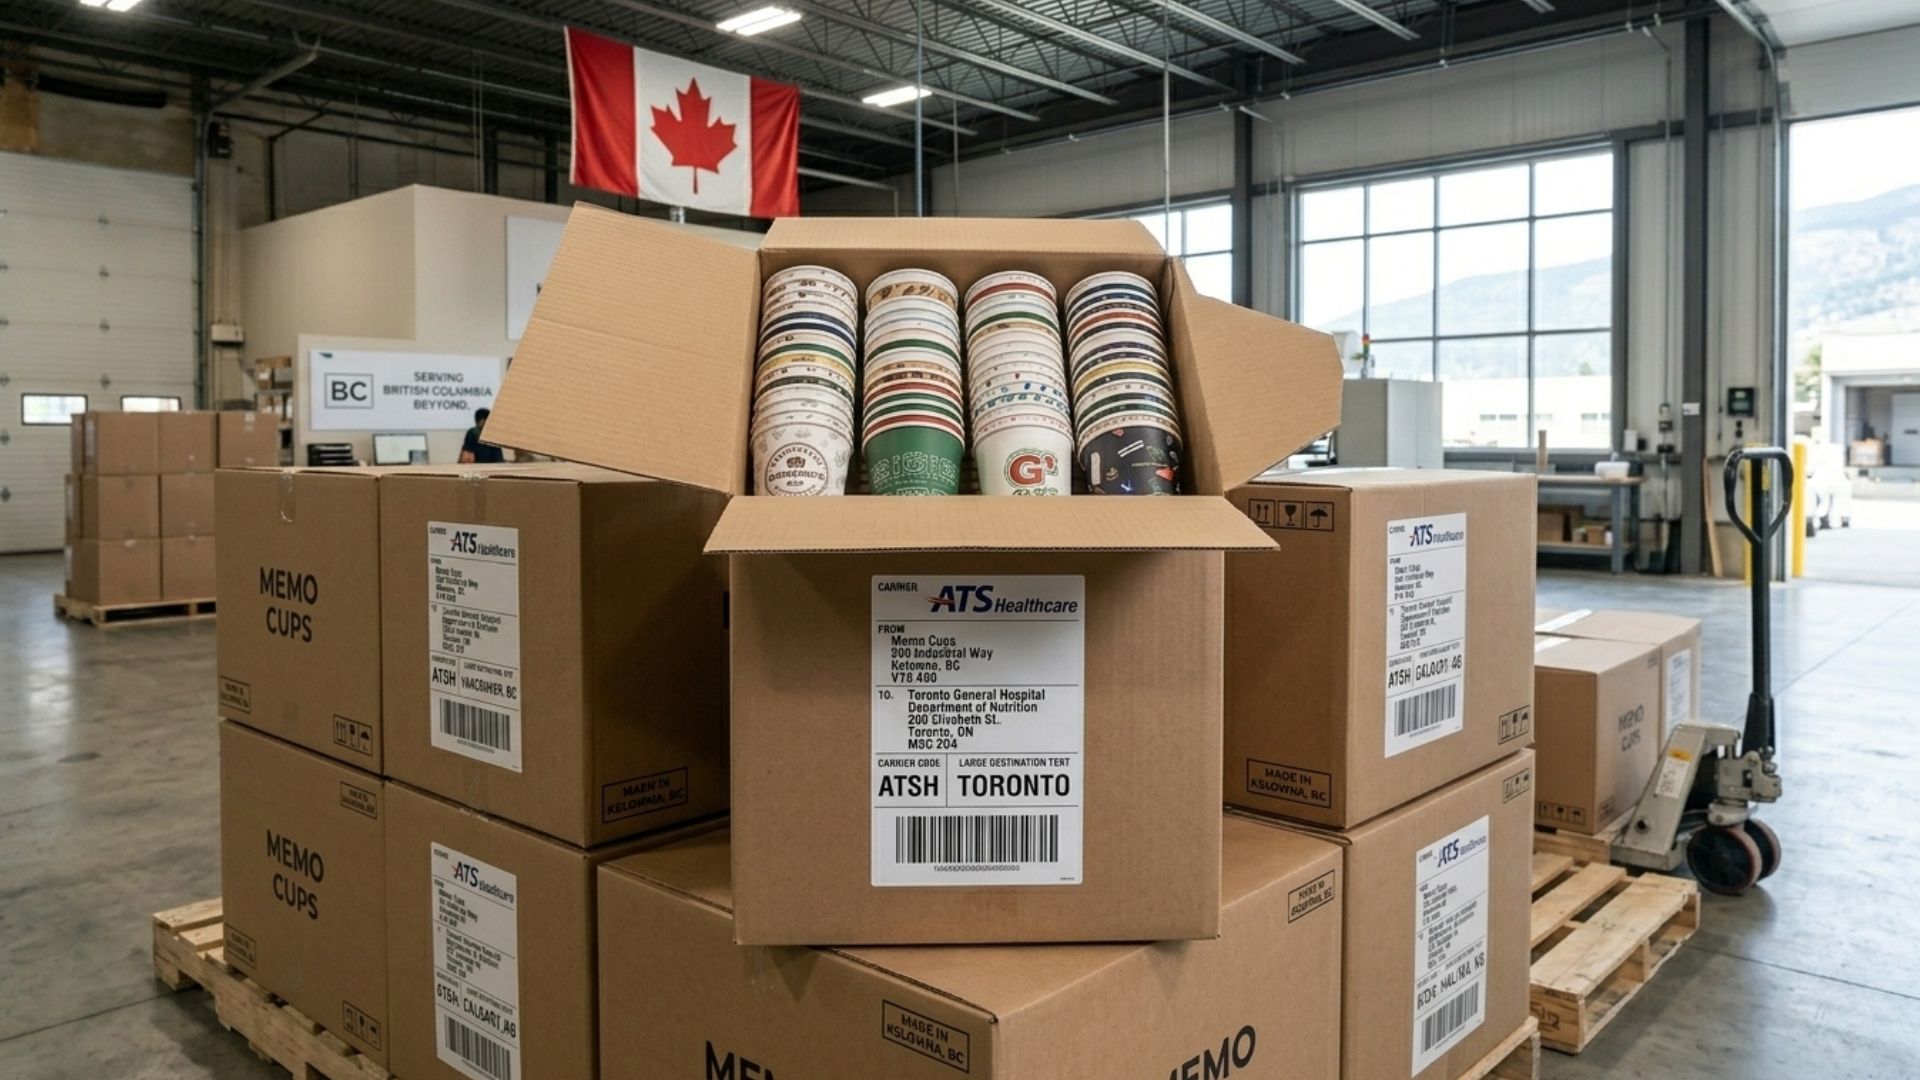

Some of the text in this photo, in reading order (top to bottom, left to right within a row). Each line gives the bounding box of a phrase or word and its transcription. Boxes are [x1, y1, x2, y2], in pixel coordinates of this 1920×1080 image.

[414, 372, 464, 382] SERVING
[331, 381, 367, 401] BC
[383, 385, 429, 396] BRITISH
[451, 531, 477, 554] ATS
[260, 566, 318, 605] MEMO
[930, 585, 1078, 613] ATS Healthcare
[266, 606, 312, 643] CUPS
[970, 648, 993, 660] Way
[432, 667, 456, 686] ATSH
[953, 689, 997, 700] General
[1000, 689, 1045, 702] Hospital
[976, 702, 987, 712] of
[990, 701, 1038, 712] Nutrition
[908, 715, 928, 725] 200
[958, 727, 974, 737] ON
[936, 739, 958, 749] 204
[878, 775, 939, 797] ATSH
[957, 774, 1070, 796] TORONTO
[1300, 774, 1312, 785] IN
[267, 829, 324, 883] MEMO
[454, 862, 479, 887] ATS
[273, 873, 319, 920] CUPS
[936, 1027, 948, 1043] IN
[948, 1048, 964, 1064] BC
